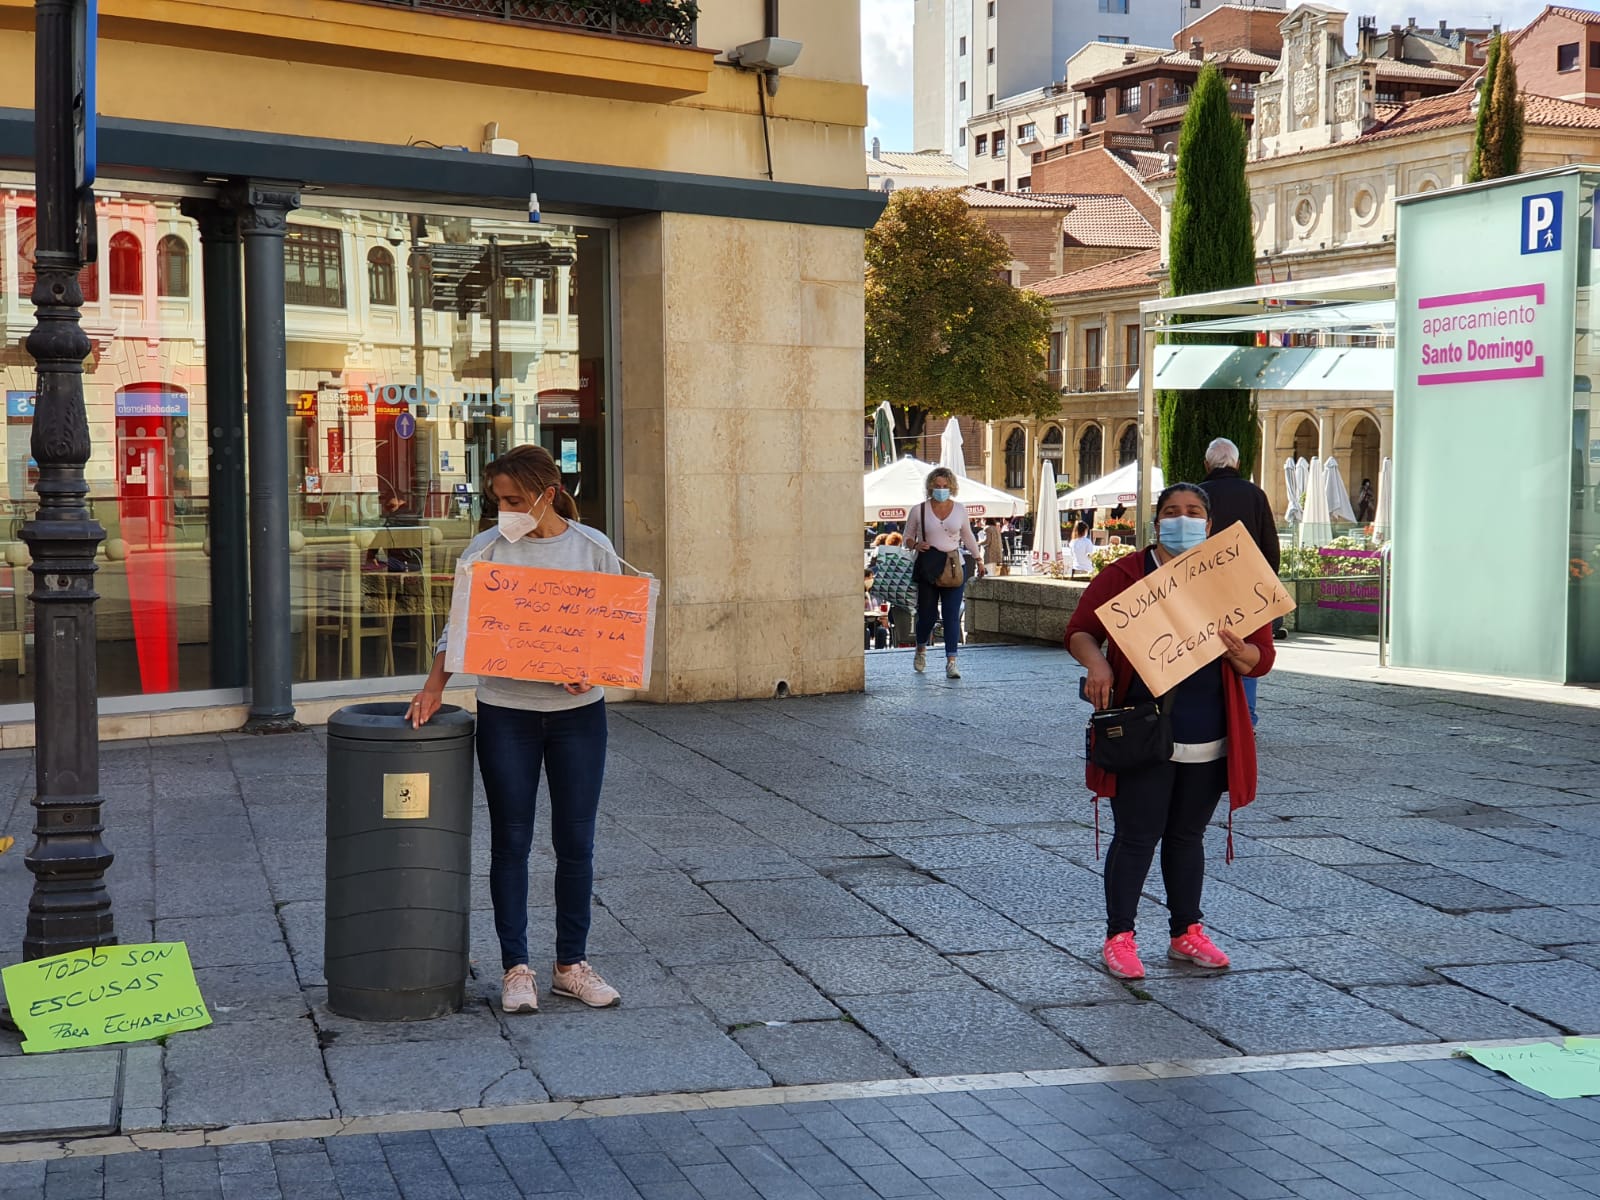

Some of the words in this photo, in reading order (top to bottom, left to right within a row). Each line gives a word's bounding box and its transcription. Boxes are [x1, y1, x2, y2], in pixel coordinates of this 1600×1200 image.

[1528, 198, 1554, 250] P
[1422, 304, 1535, 337] aparcamiento
[1421, 343, 1462, 365] Santo
[1467, 336, 1533, 363] Domingo
[364, 374, 512, 406] vodafone
[514, 598, 550, 613] PAGO
[558, 603, 580, 615] MIS
[585, 606, 643, 624] IMPUESTOS
[1110, 575, 1178, 630] SUSANA
[478, 615, 510, 632] PERO
[518, 622, 533, 632] EL
[539, 624, 586, 638] ALCALDE
[608, 632, 625, 641] LA
[508, 637, 580, 653] CONCEJALA
[481, 658, 508, 672] NO
[38, 953, 109, 981] TODO
[120, 946, 173, 966] SON
[29, 973, 164, 1017] ESCUSAS
[48, 1022, 90, 1039] PARA
[104, 1004, 204, 1035] ECHARNOS
